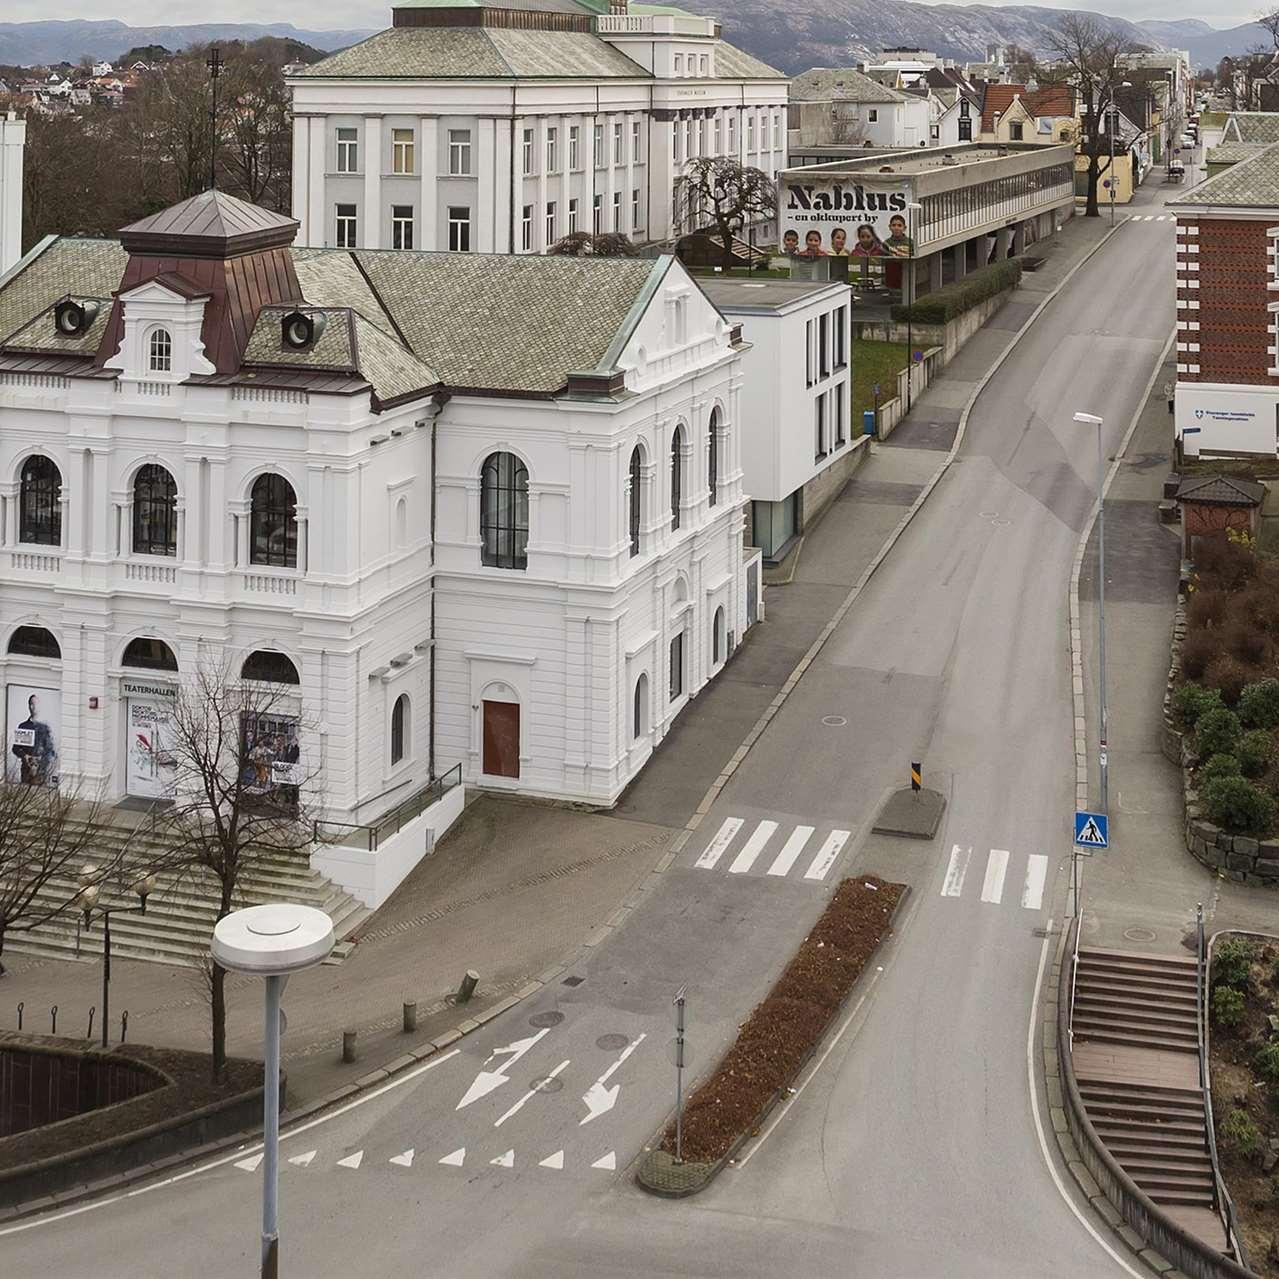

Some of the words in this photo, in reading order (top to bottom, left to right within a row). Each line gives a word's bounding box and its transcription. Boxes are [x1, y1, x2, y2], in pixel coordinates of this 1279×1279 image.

[787, 184, 906, 212] Nablus
[794, 214, 808, 222] en
[810, 213, 862, 224] okkupert
[864, 213, 879, 224] by
[124, 684, 176, 697] TEATERHALLEN
